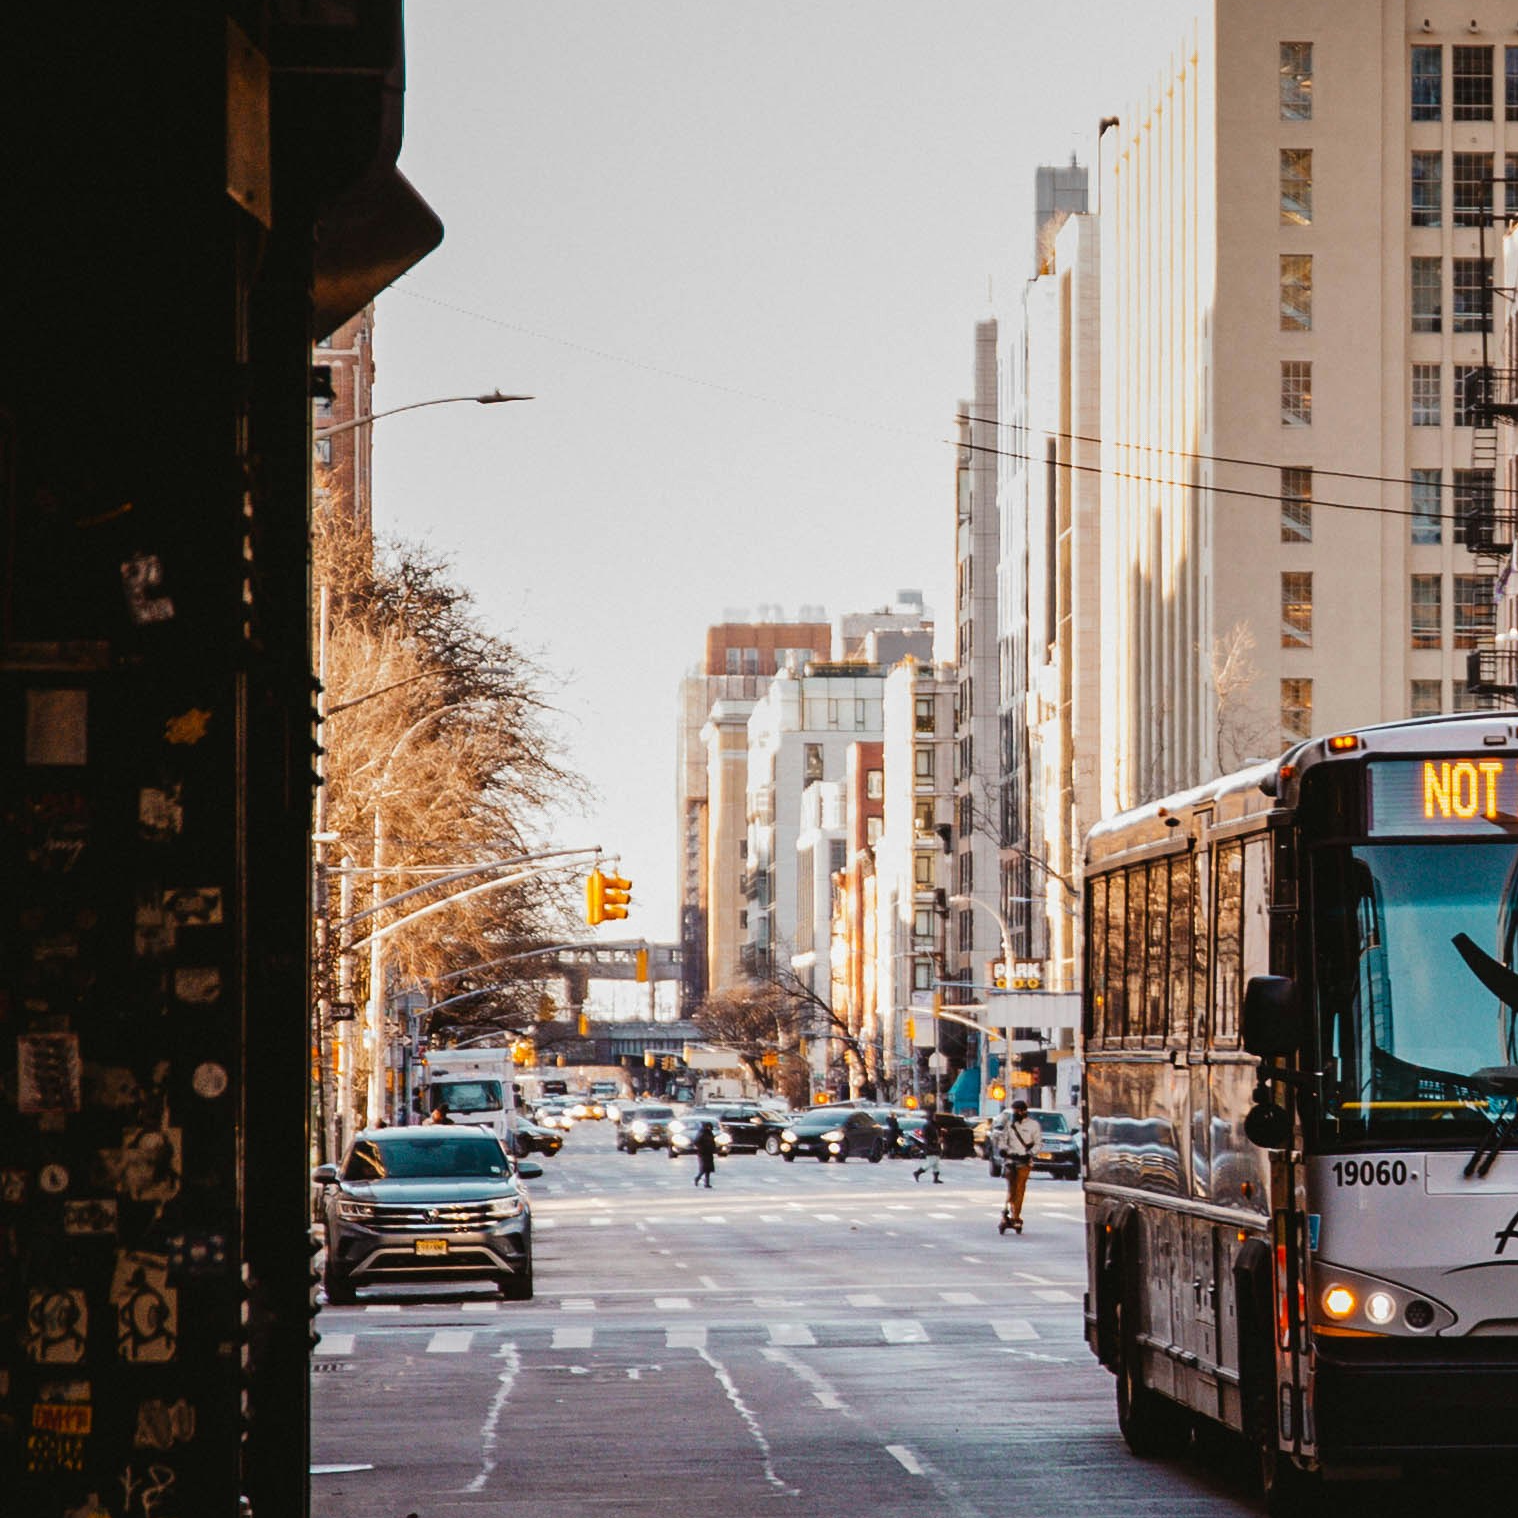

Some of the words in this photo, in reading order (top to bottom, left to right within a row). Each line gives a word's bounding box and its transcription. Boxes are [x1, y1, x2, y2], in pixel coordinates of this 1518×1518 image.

[1423, 760, 1504, 819] NOT
[994, 963, 1040, 978] PRK
[1332, 1160, 1407, 1187] 19060
